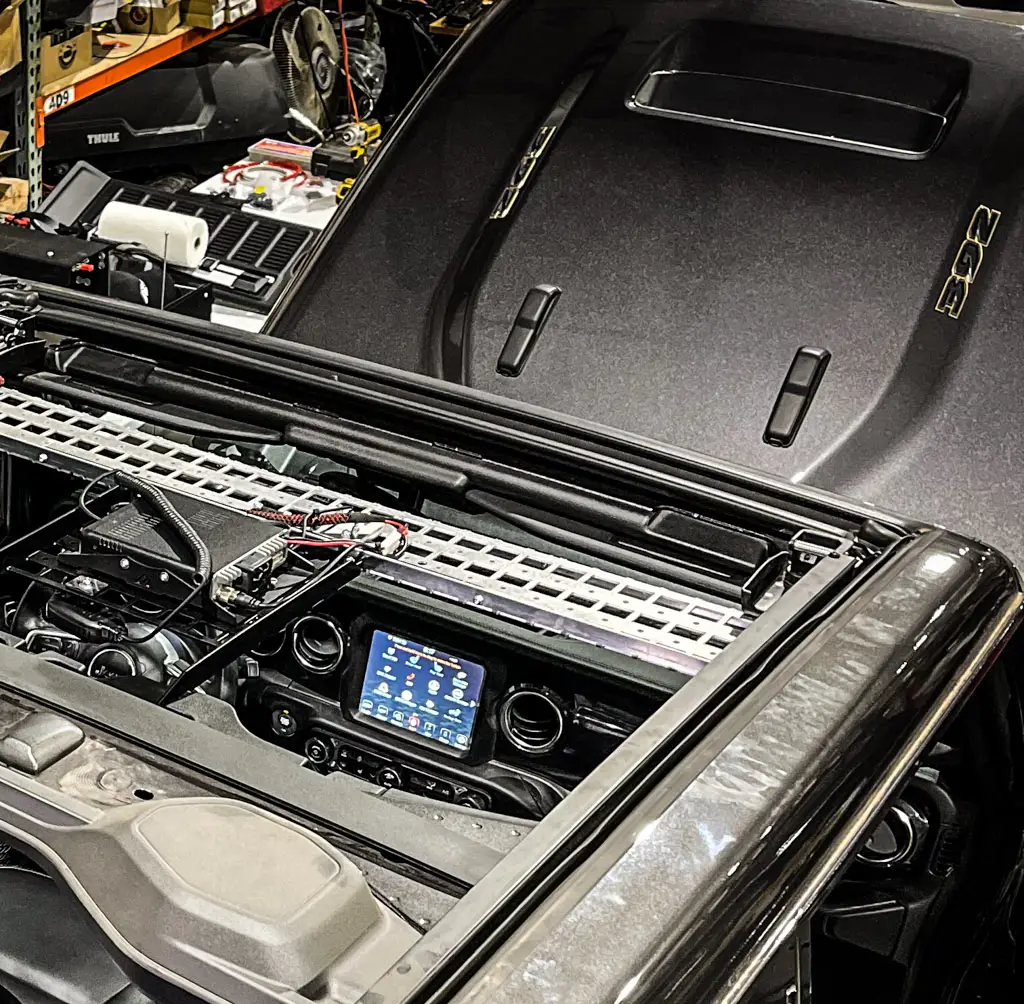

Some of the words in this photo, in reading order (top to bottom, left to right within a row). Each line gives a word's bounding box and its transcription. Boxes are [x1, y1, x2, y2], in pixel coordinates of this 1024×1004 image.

[49, 90, 69, 109] AD9
[87, 132, 120, 145] THULE
[935, 204, 1001, 319] 392
